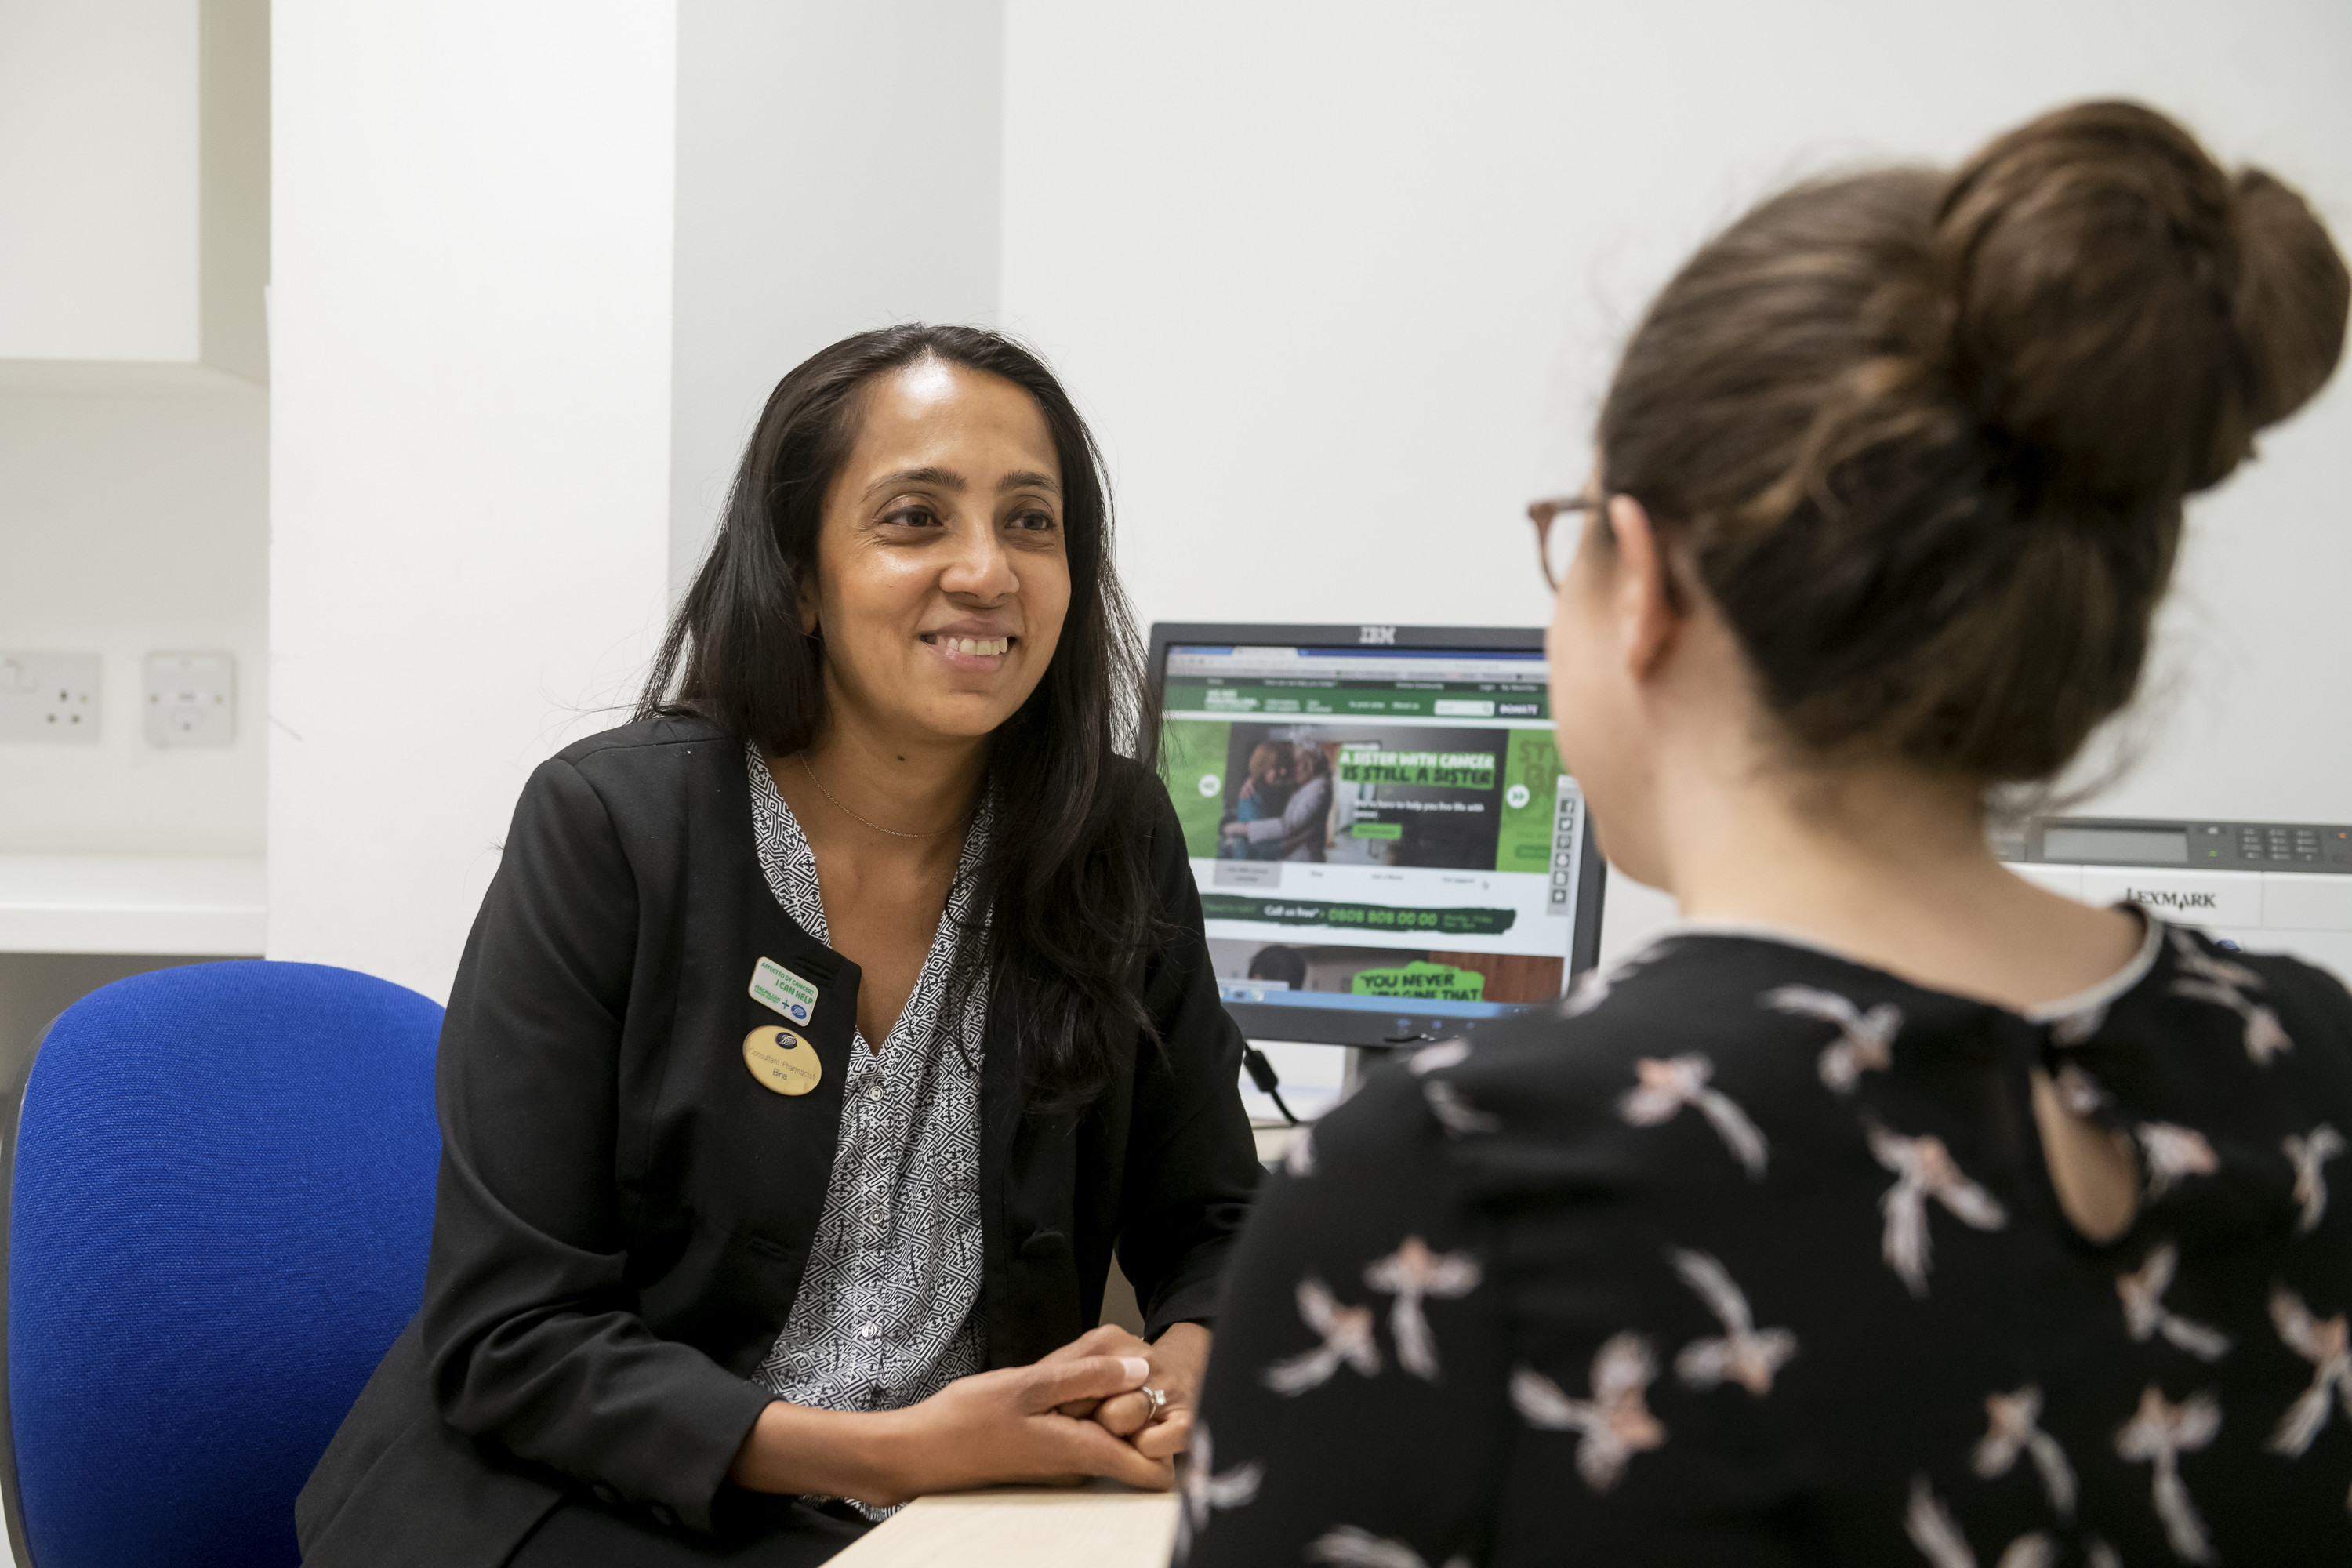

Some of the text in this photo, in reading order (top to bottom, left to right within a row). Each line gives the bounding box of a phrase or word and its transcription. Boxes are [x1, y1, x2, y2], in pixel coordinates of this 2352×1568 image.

[1359, 626, 1396, 644] IBM
[1499, 704, 1538, 715] DONATE
[1339, 751, 1494, 769] A SISTER WITH CANCER
[1342, 766, 1493, 785] IS STILL A SISTER
[1265, 904, 1283, 916] Call
[1397, 911, 1417, 926] 00
[1417, 912, 1438, 927] 00
[761, 962, 785, 979] AFFECTED
[792, 980, 815, 996] CANCER?
[1401, 974, 1455, 988] NEVER
[779, 982, 796, 995] CAN
[795, 990, 813, 1004] HELP
[1442, 989, 1479, 1001] THAT
[749, 1047, 816, 1080] Consultant Pharmacist
[772, 1068, 788, 1080] Bina
